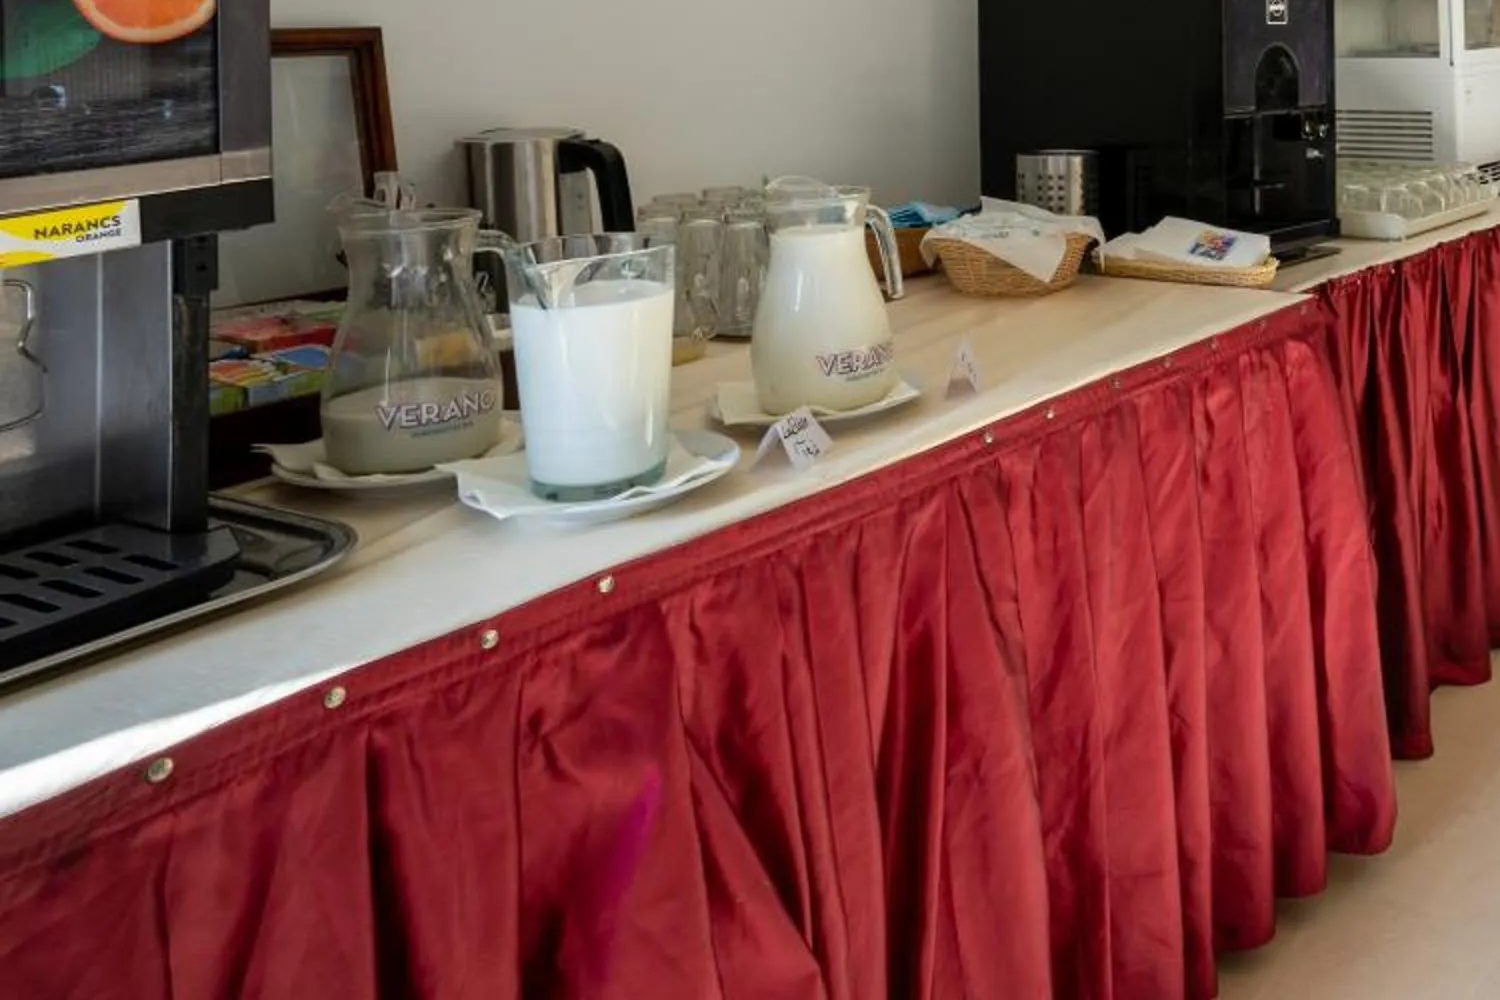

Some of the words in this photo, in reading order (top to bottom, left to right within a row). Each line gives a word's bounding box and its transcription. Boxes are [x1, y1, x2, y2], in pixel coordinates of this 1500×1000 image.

[33, 215, 121, 241] NARANCS
[75, 228, 121, 242] ORANGE
[374, 389, 496, 432] VERANO
